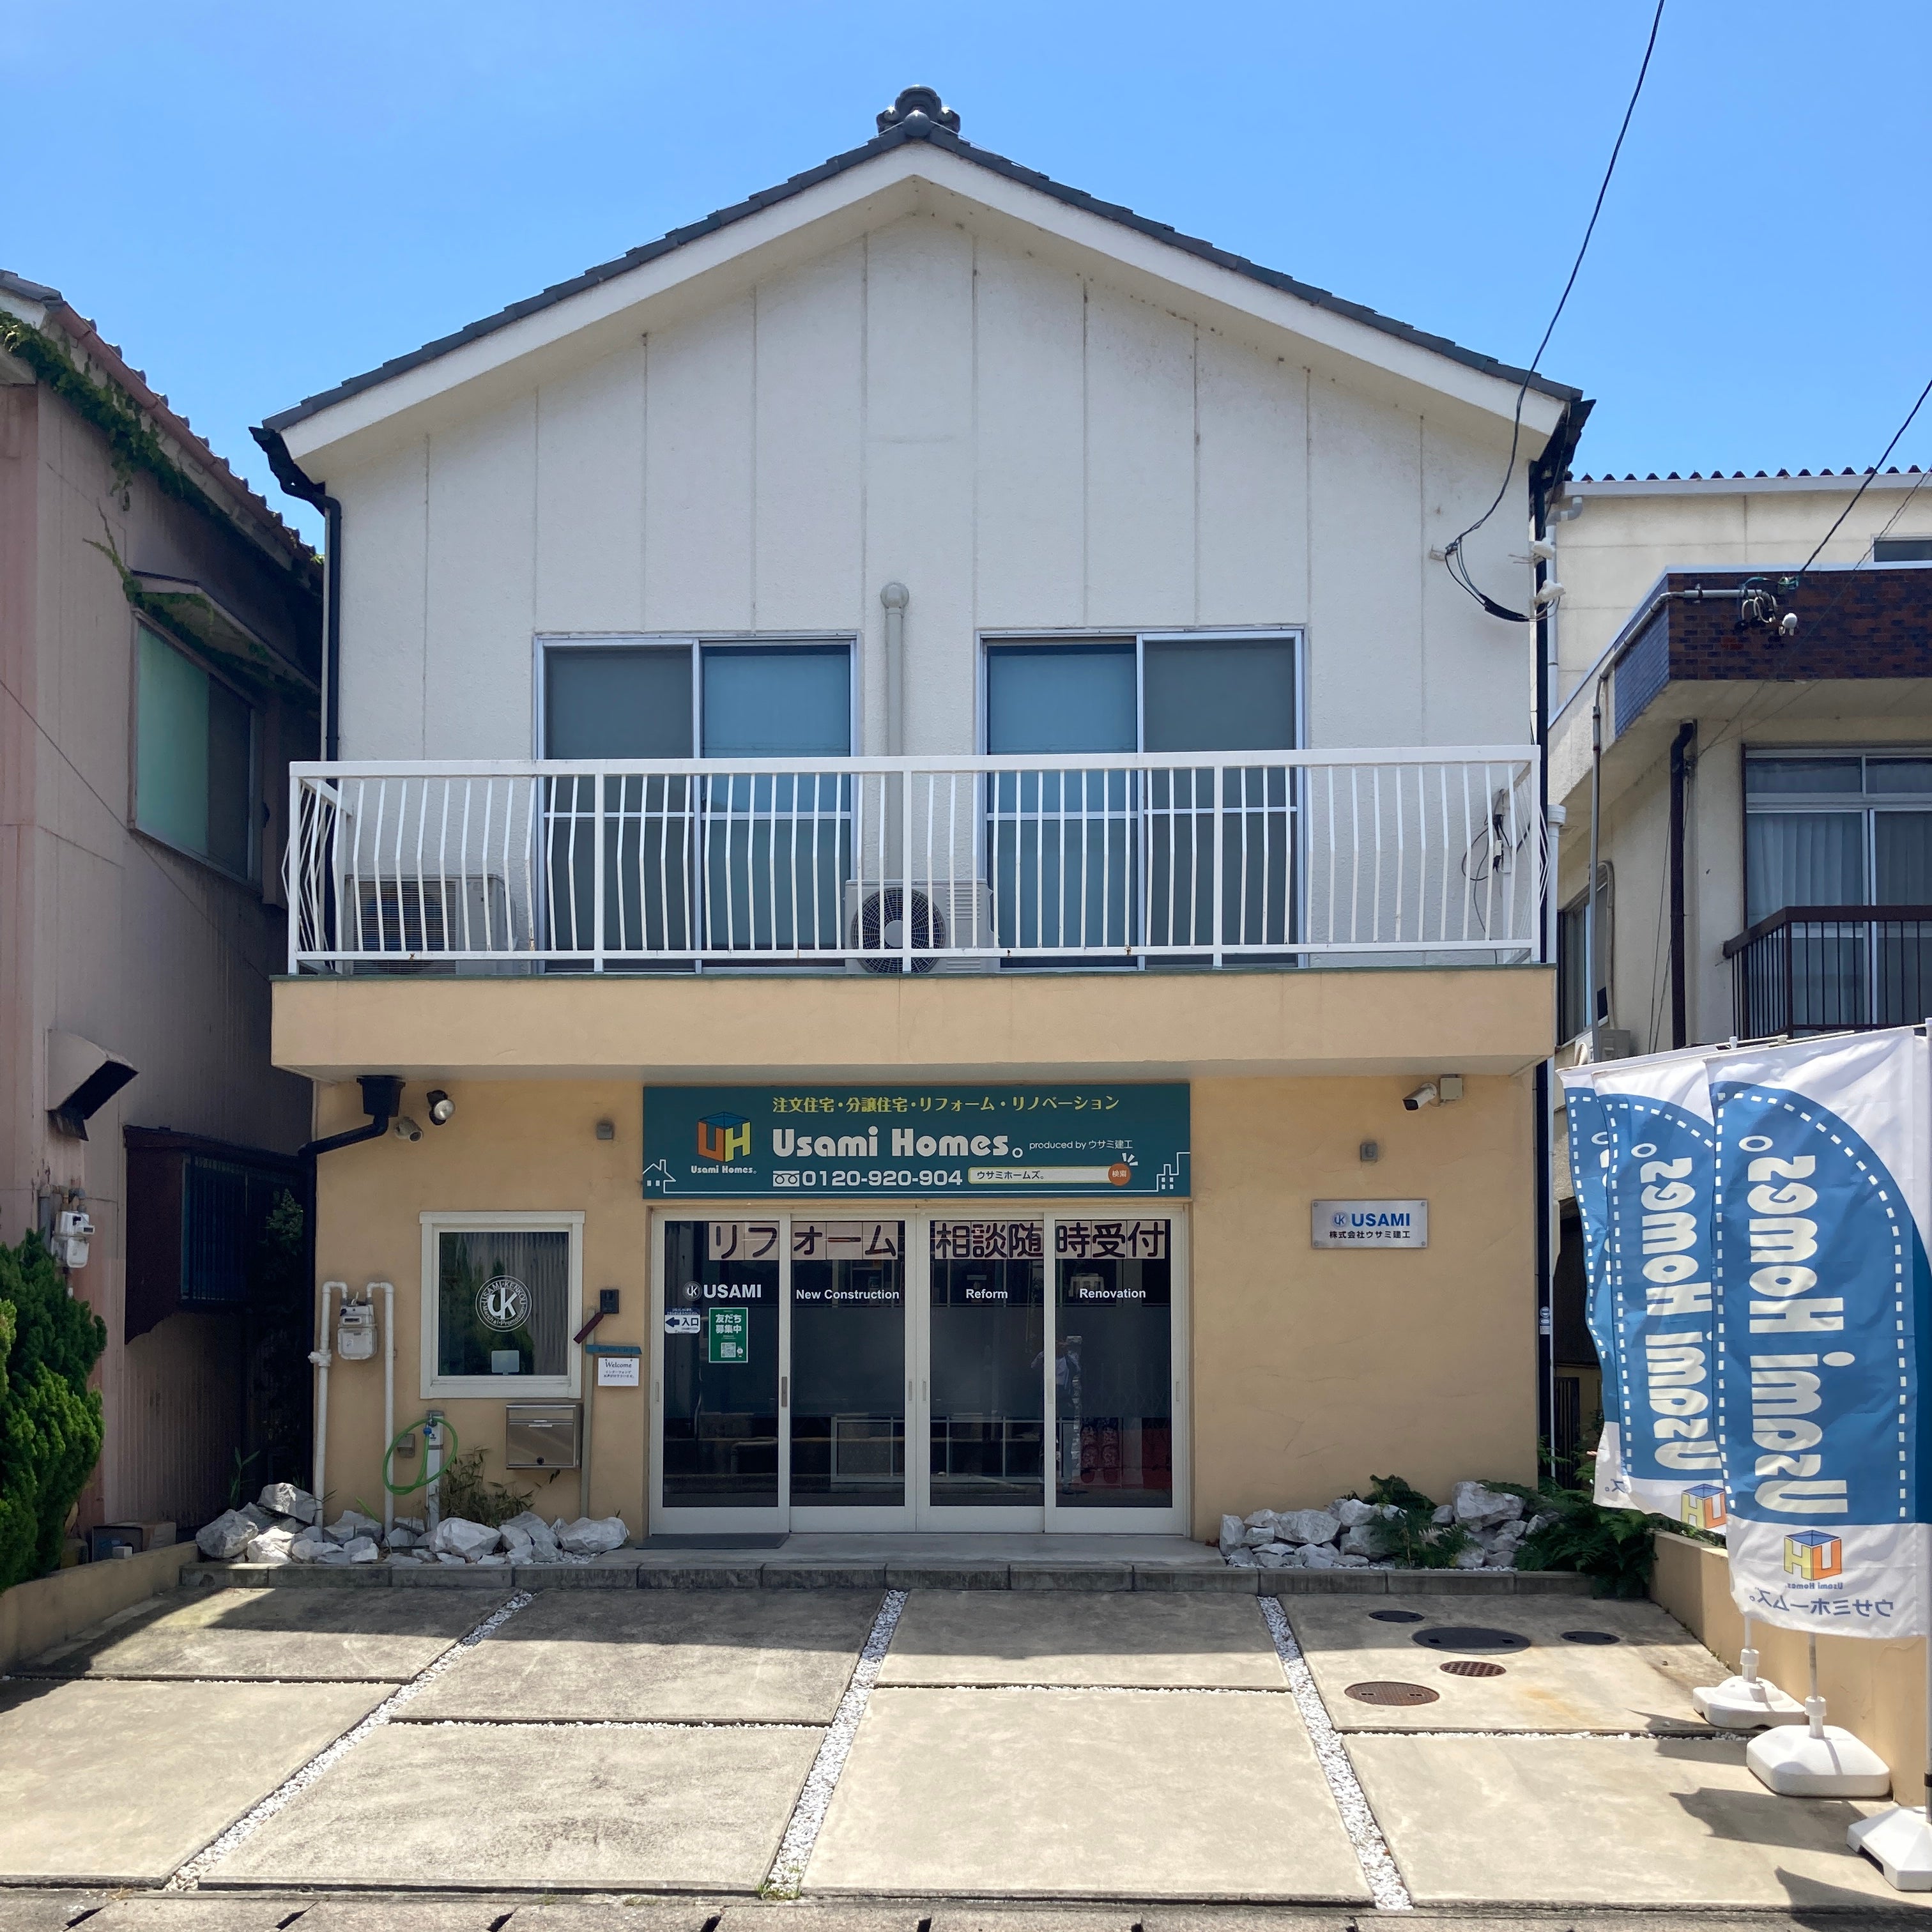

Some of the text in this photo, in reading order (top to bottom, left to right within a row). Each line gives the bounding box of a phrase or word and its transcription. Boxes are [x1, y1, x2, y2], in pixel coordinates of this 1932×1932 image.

[772, 1126, 878, 1157] Usami
[1029, 1139, 1133, 1151] produced by ウサミ建工
[691, 1165, 719, 1174] Usami
[1112, 1170, 1128, 1179] 検索
[802, 1170, 963, 1186] 0120-920-904
[1351, 1213, 1411, 1227] USAMI
[935, 1221, 1165, 1259] 相談随時受付
[1329, 1230, 1411, 1239] 株式会社ウサミ建工
[481, 1281, 527, 1305] USAMI KENKOU
[703, 1284, 762, 1299] USAMI
[796, 1289, 900, 1300] New Construction
[966, 1289, 1008, 1299] Reform
[1079, 1288, 1146, 1299] Renovation
[682, 1317, 699, 1326] 入口
[715, 1314, 742, 1323] 友だち
